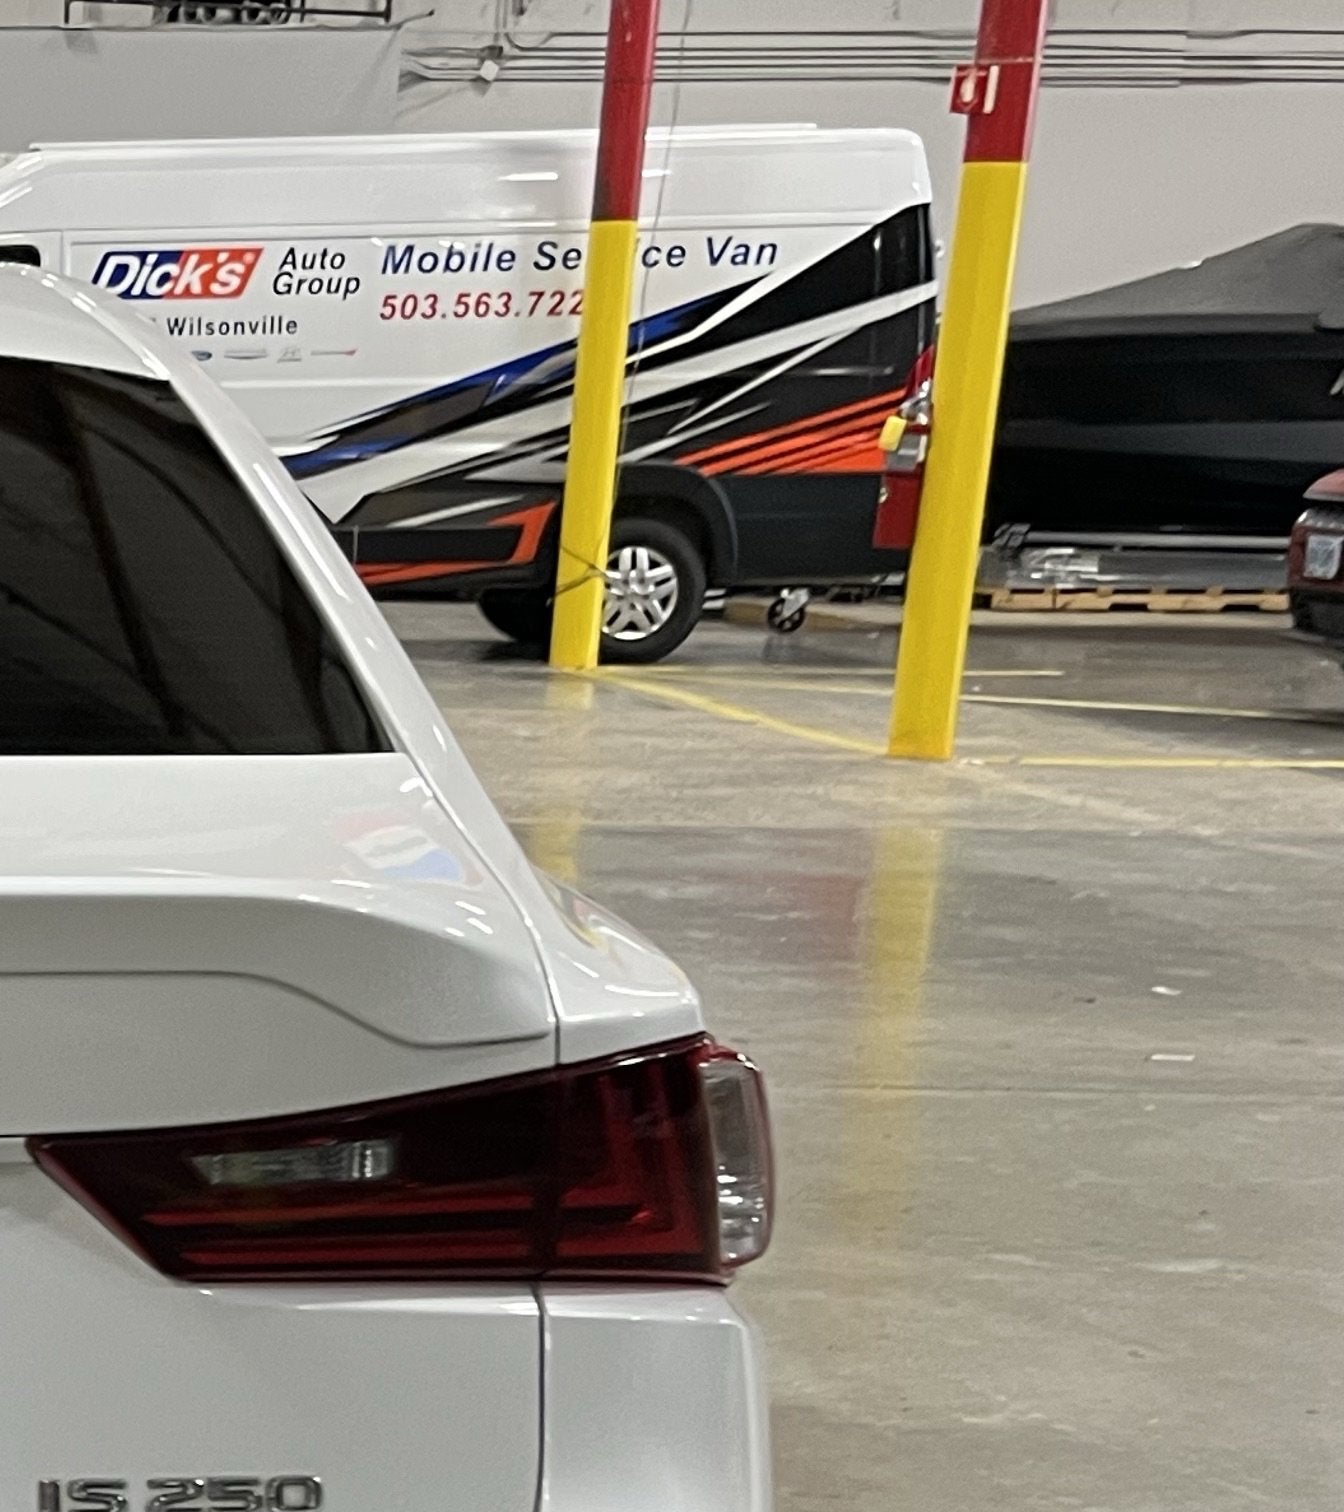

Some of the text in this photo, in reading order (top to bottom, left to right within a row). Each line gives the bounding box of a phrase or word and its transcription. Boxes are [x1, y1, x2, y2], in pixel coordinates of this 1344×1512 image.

[278, 247, 346, 271] Auto
[380, 240, 517, 275] Mobile
[706, 236, 779, 267] Van
[95, 252, 246, 297] Dick's
[272, 271, 361, 301] Group
[167, 315, 299, 337] Wilsonville
